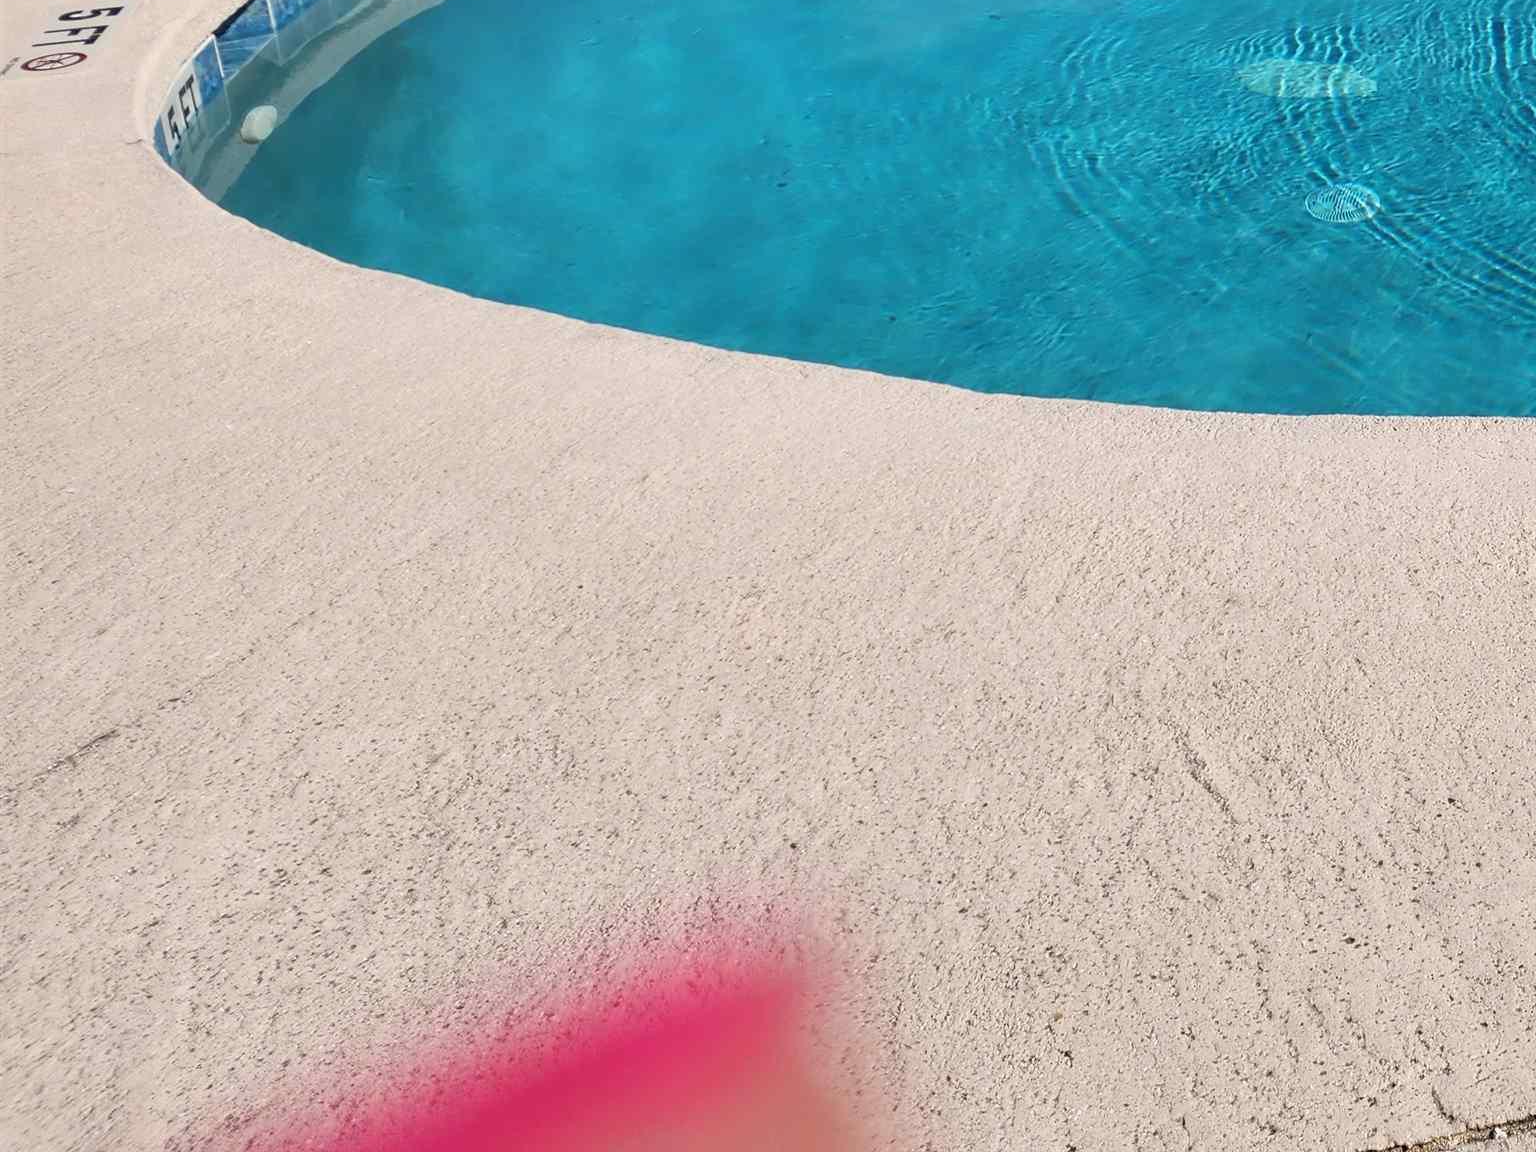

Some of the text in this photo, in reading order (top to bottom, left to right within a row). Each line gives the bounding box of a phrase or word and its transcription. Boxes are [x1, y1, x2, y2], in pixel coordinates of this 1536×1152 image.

[31, 6, 125, 48] 5 FT
[178, 73, 200, 129] FT
